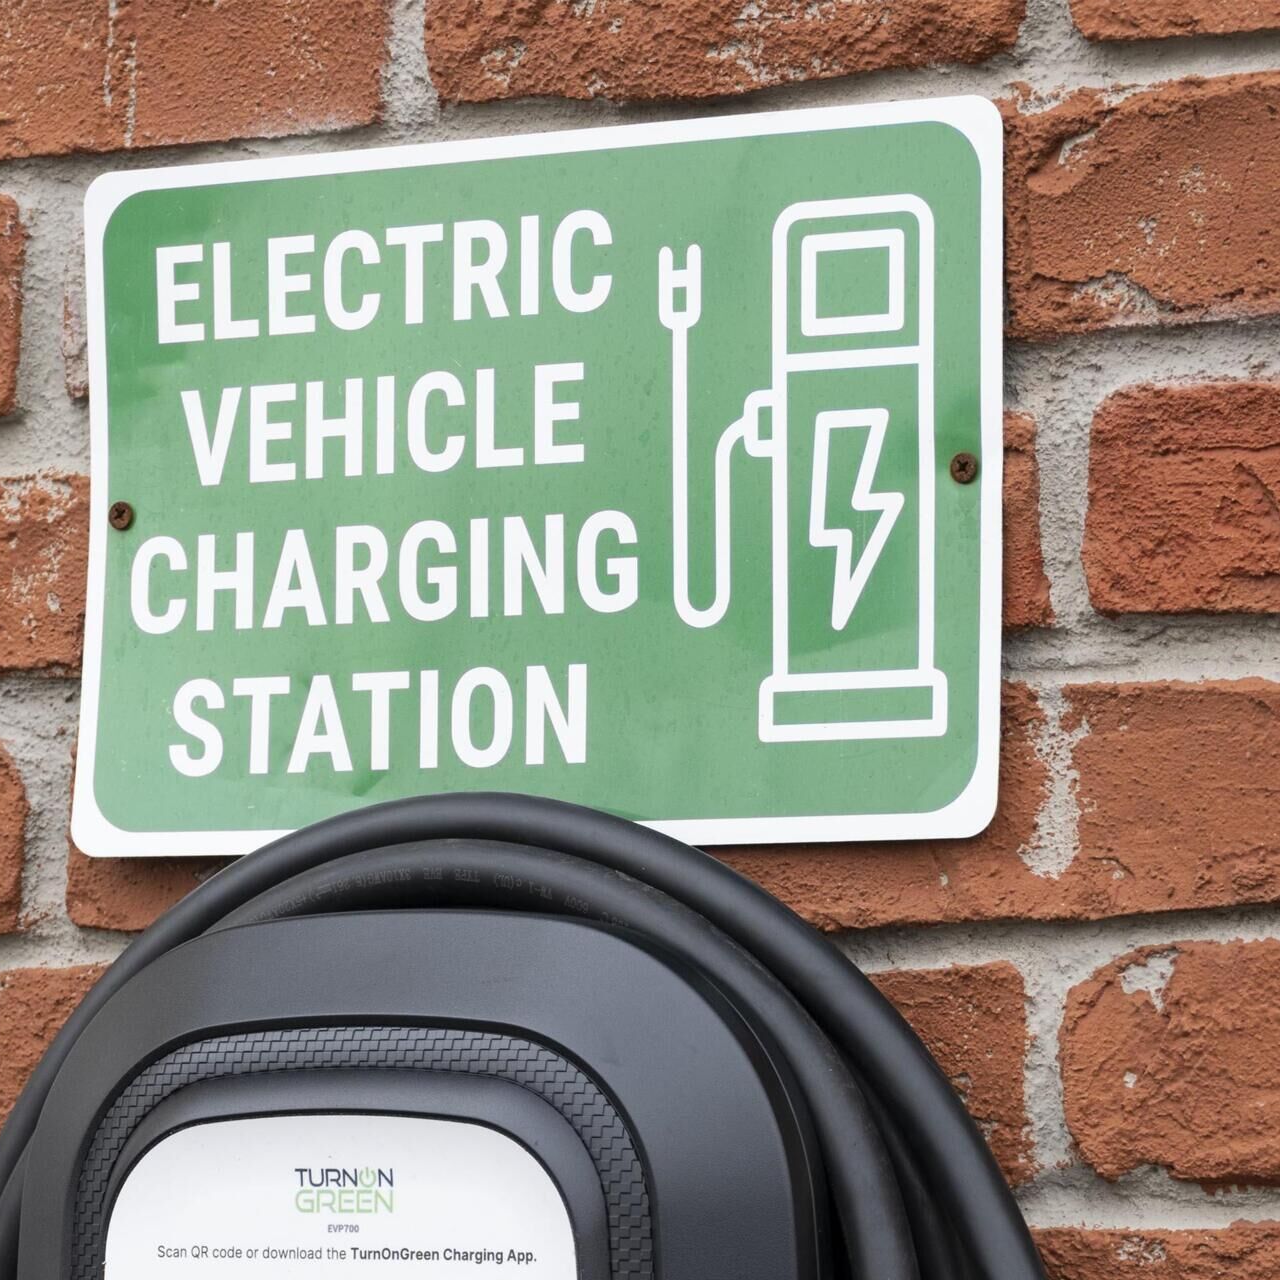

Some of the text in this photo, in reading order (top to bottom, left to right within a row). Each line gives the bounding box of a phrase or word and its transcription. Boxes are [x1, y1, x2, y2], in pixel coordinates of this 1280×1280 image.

[156, 210, 612, 344] ELECTRIC
[181, 362, 584, 486] VEHICLE
[131, 510, 638, 634] CHARGING
[169, 664, 587, 777] STATION
[157, 1244, 537, 1266] Scan QR code or download the TurnOnGreen Charging App.
[294, 1188, 394, 1214] GREEN
[327, 1223, 360, 1234] EVP700
